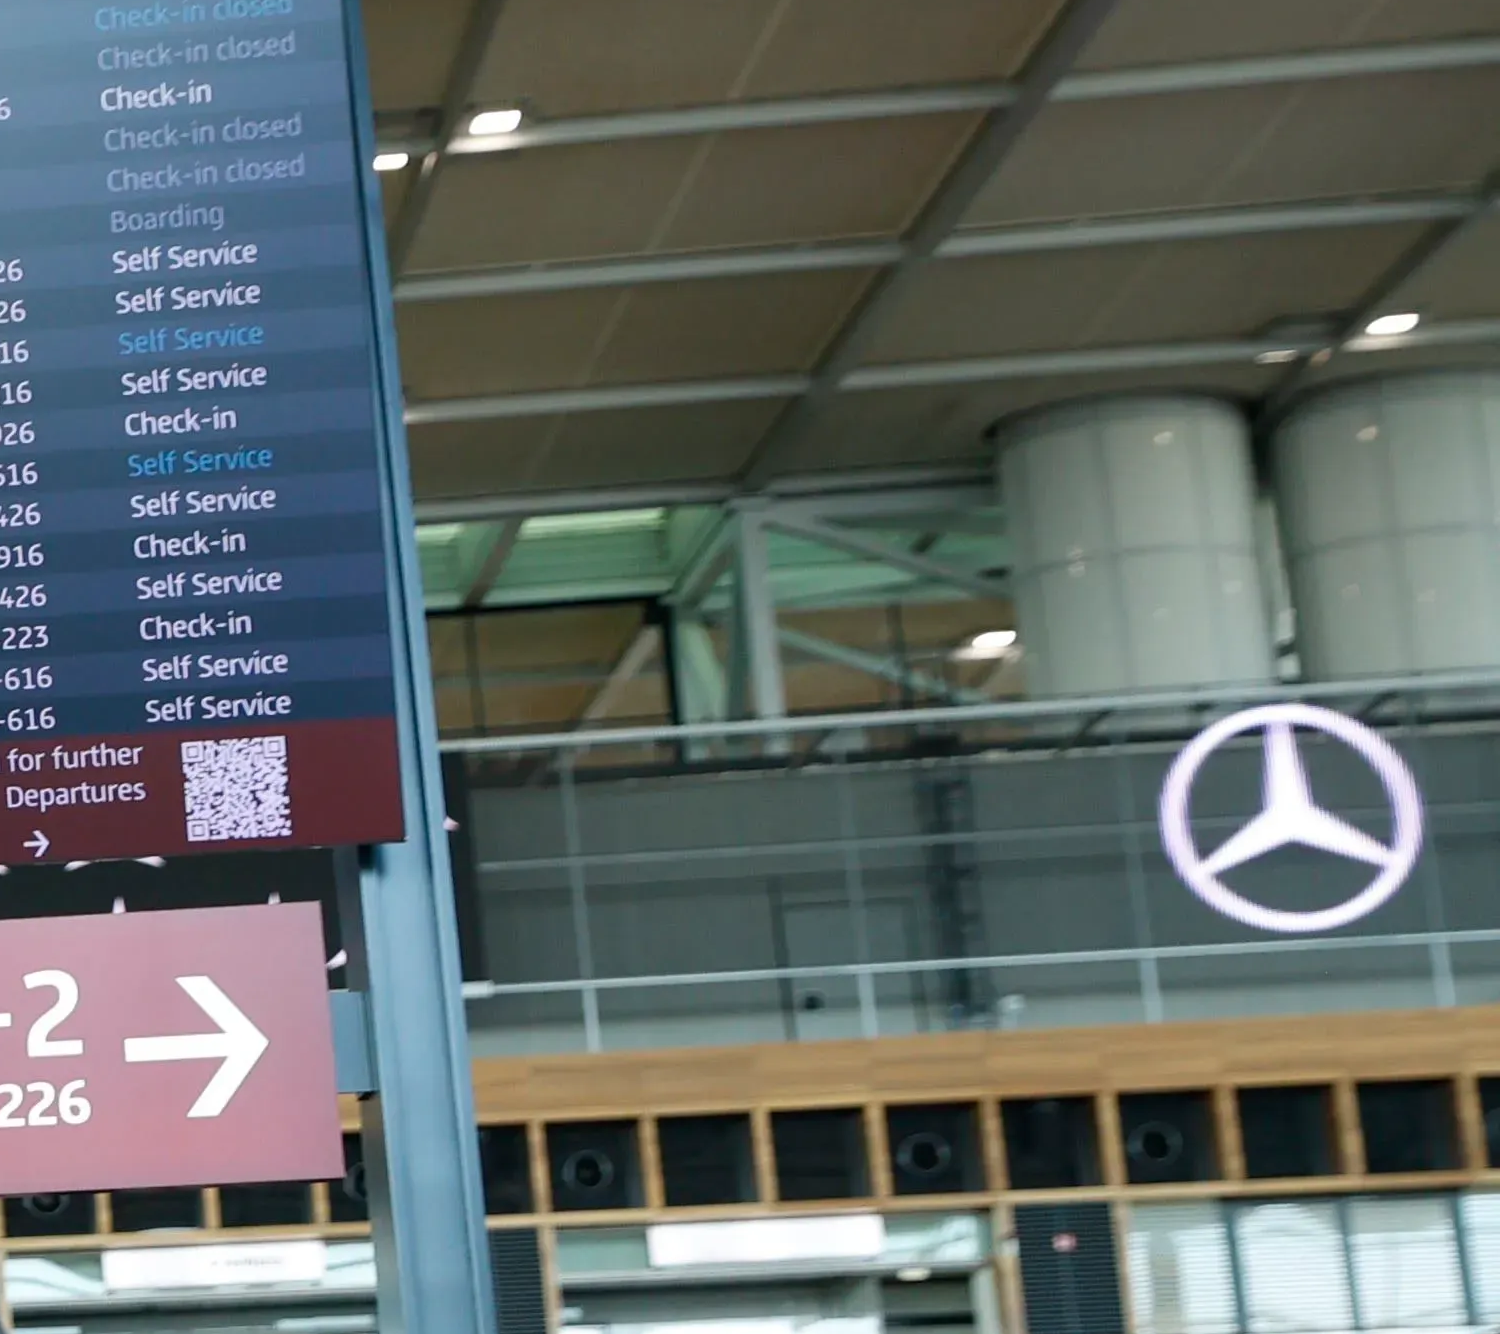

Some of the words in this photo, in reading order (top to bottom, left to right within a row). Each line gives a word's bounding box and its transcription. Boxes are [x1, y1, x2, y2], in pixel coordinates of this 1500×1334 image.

[100, 78, 212, 112] Check-in
[133, 528, 246, 559] Check-in
[144, 694, 196, 723] Self
[200, 690, 292, 720] Service
[6, 747, 46, 773] for
[50, 742, 144, 770] further
[6, 781, 147, 813] Departures
